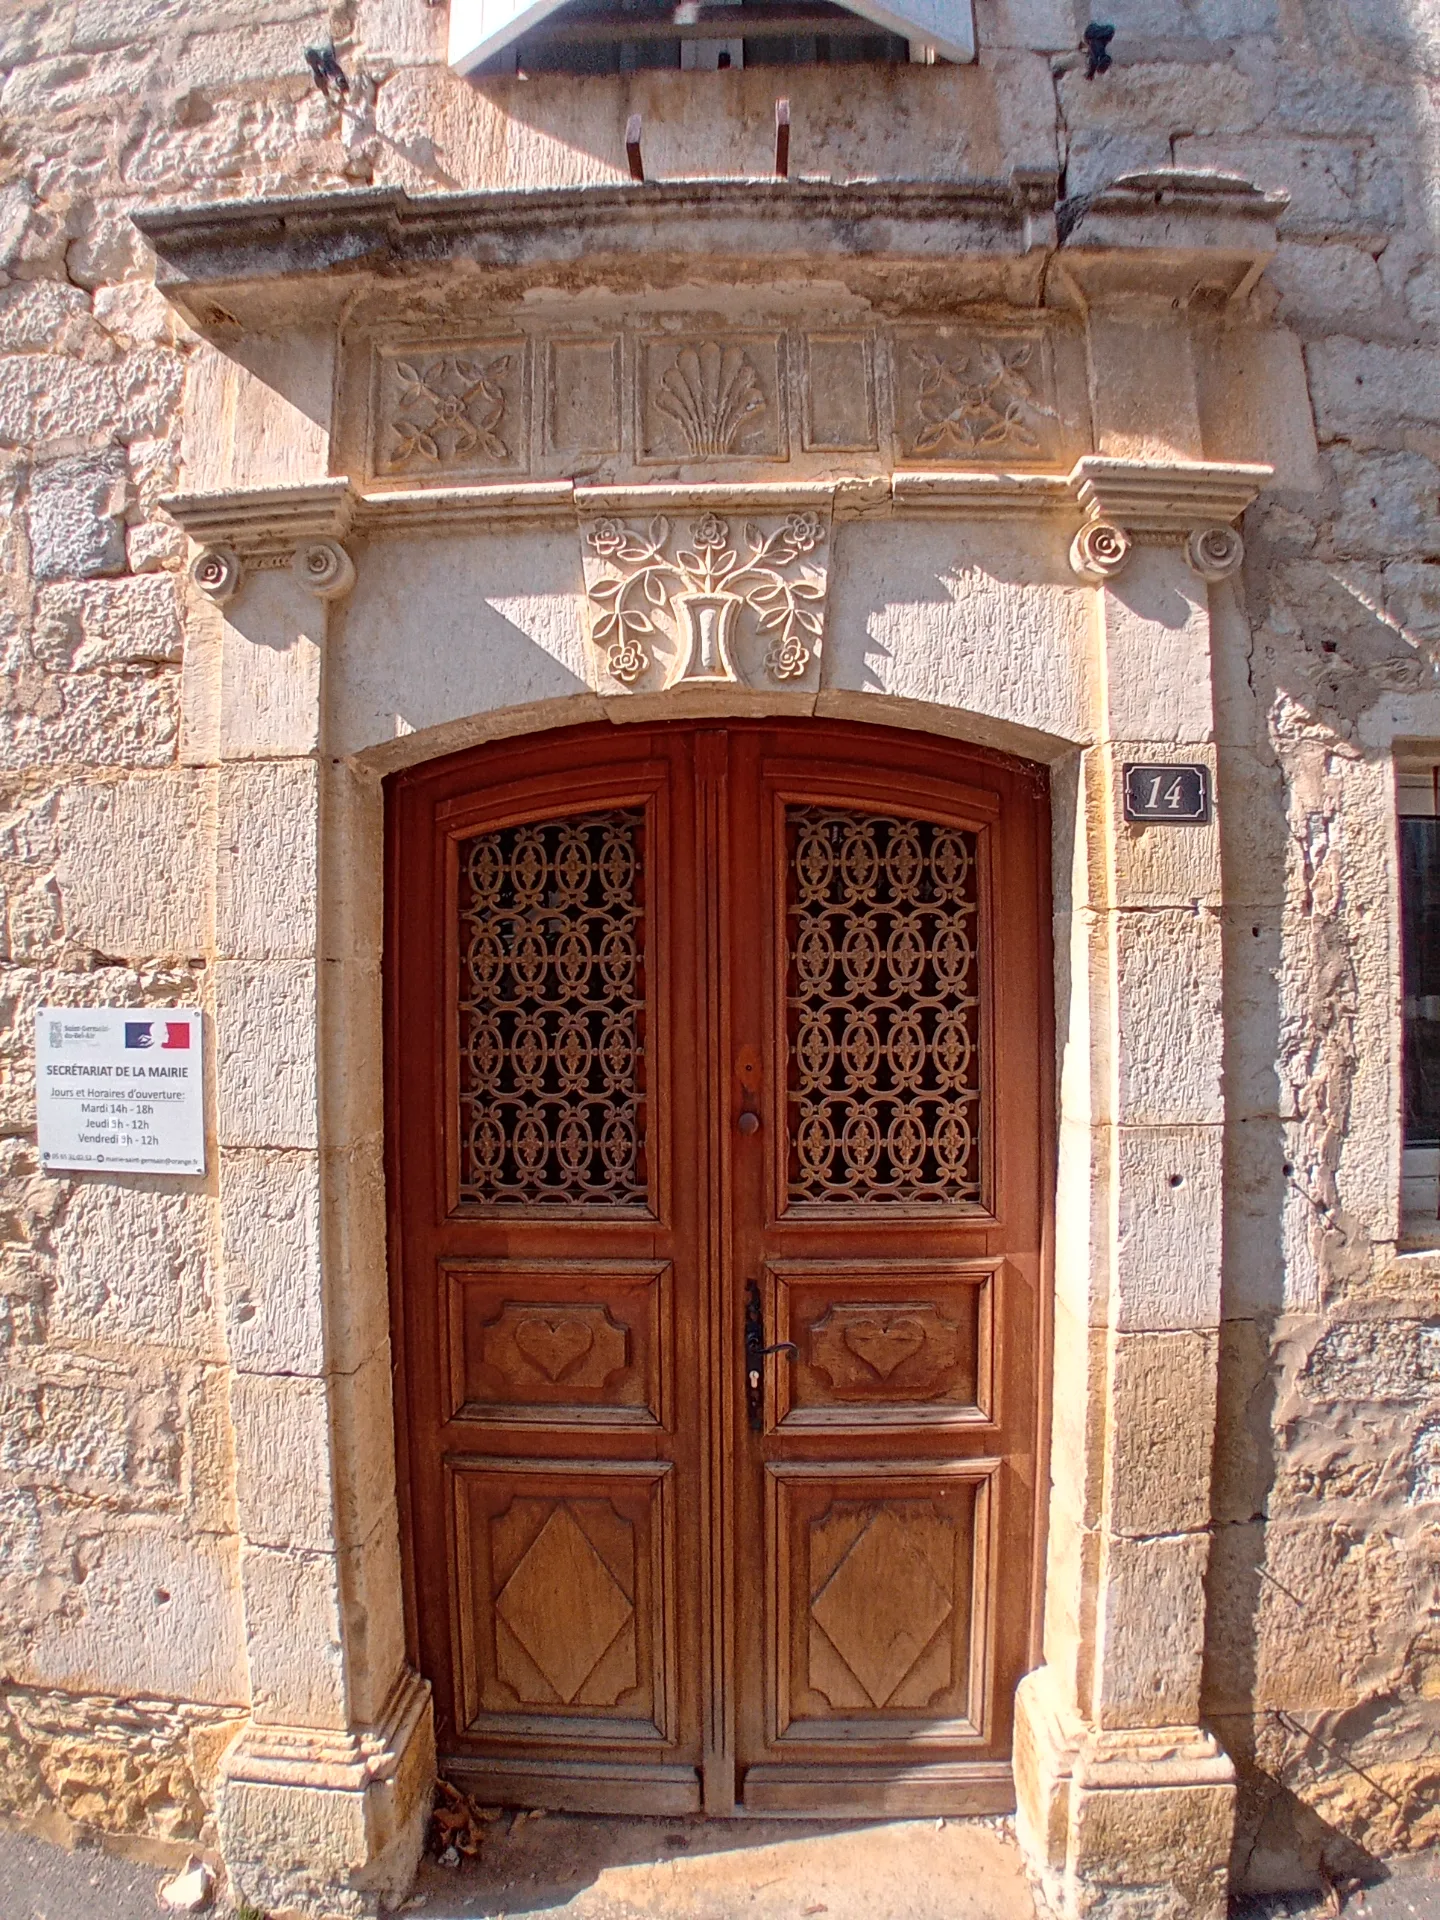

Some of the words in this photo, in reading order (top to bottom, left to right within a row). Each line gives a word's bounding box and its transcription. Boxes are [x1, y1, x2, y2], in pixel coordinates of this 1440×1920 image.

[1144, 776, 1182, 808] 14
[47, 1064, 113, 1076] SECRÉTARIAT
[116, 1068, 130, 1076] DE
[132, 1068, 146, 1077] LA
[148, 1068, 188, 1077] MAIRIE
[51, 1088, 74, 1097] Jours
[88, 1089, 125, 1098] Horaires
[82, 1104, 108, 1112] Mardi
[111, 1104, 127, 1113] 14h
[136, 1105, 153, 1114] 18h
[86, 1119, 109, 1128] Jeudi
[132, 1120, 149, 1129] 12h
[78, 1134, 118, 1144] Vendredi
[141, 1136, 158, 1145] 12h
